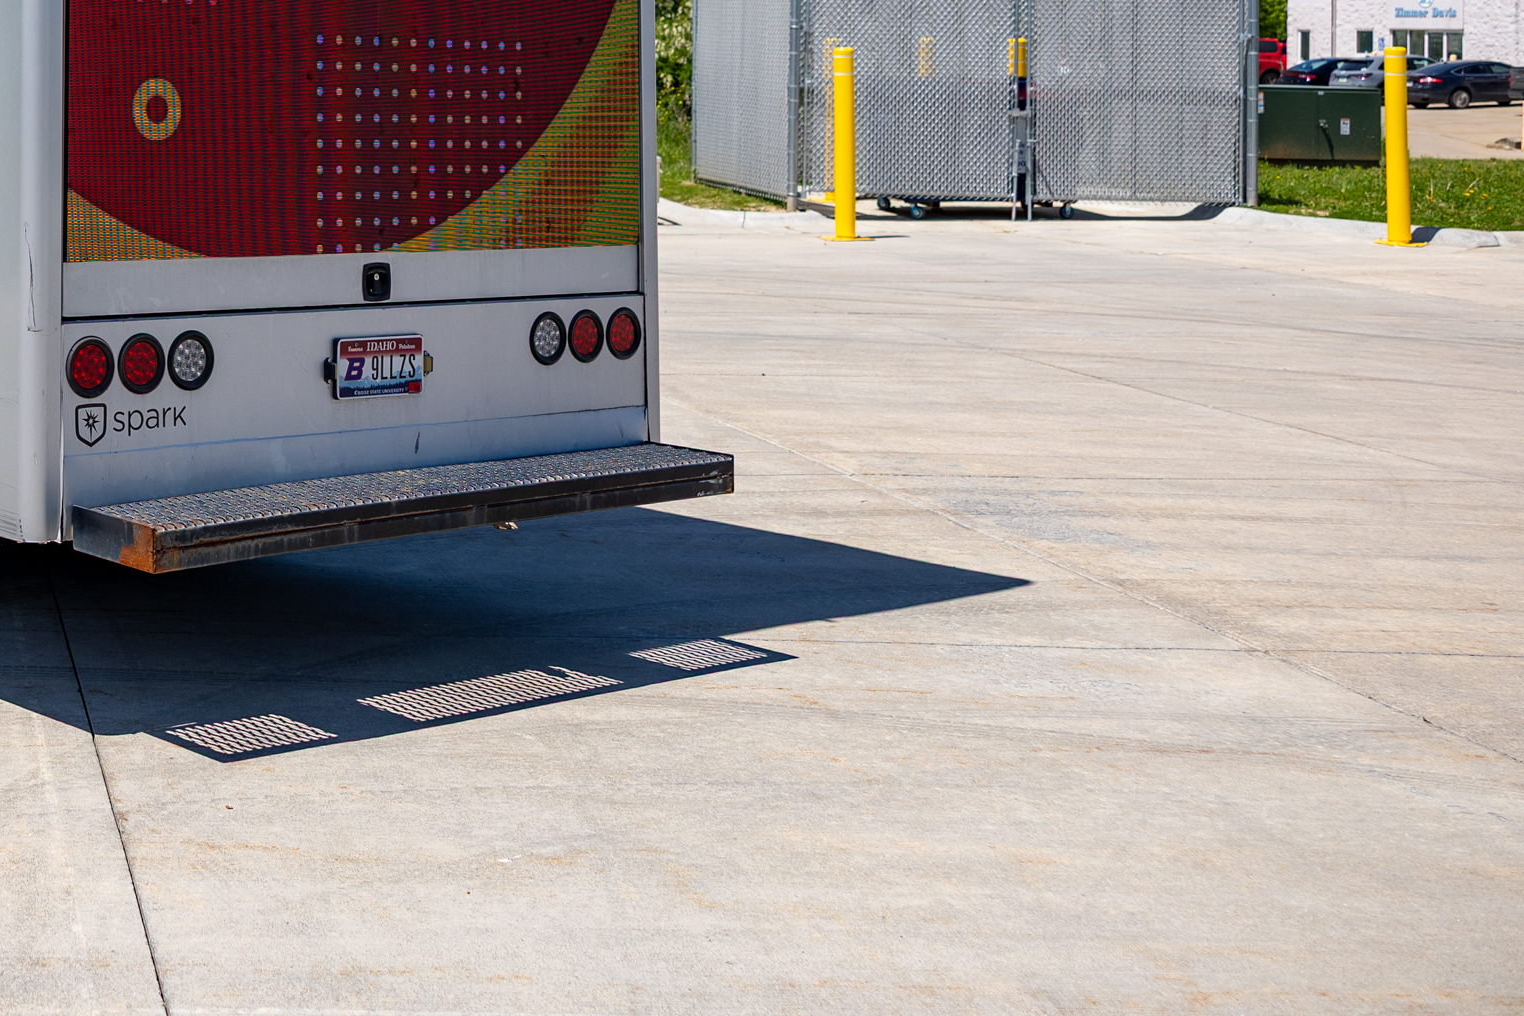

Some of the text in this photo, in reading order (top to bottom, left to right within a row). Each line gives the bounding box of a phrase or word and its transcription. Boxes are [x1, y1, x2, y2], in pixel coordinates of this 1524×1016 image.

[1395, 7, 1457, 18] Zimmer Davis
[366, 340, 397, 352] IDAHO
[113, 405, 187, 437] spark
